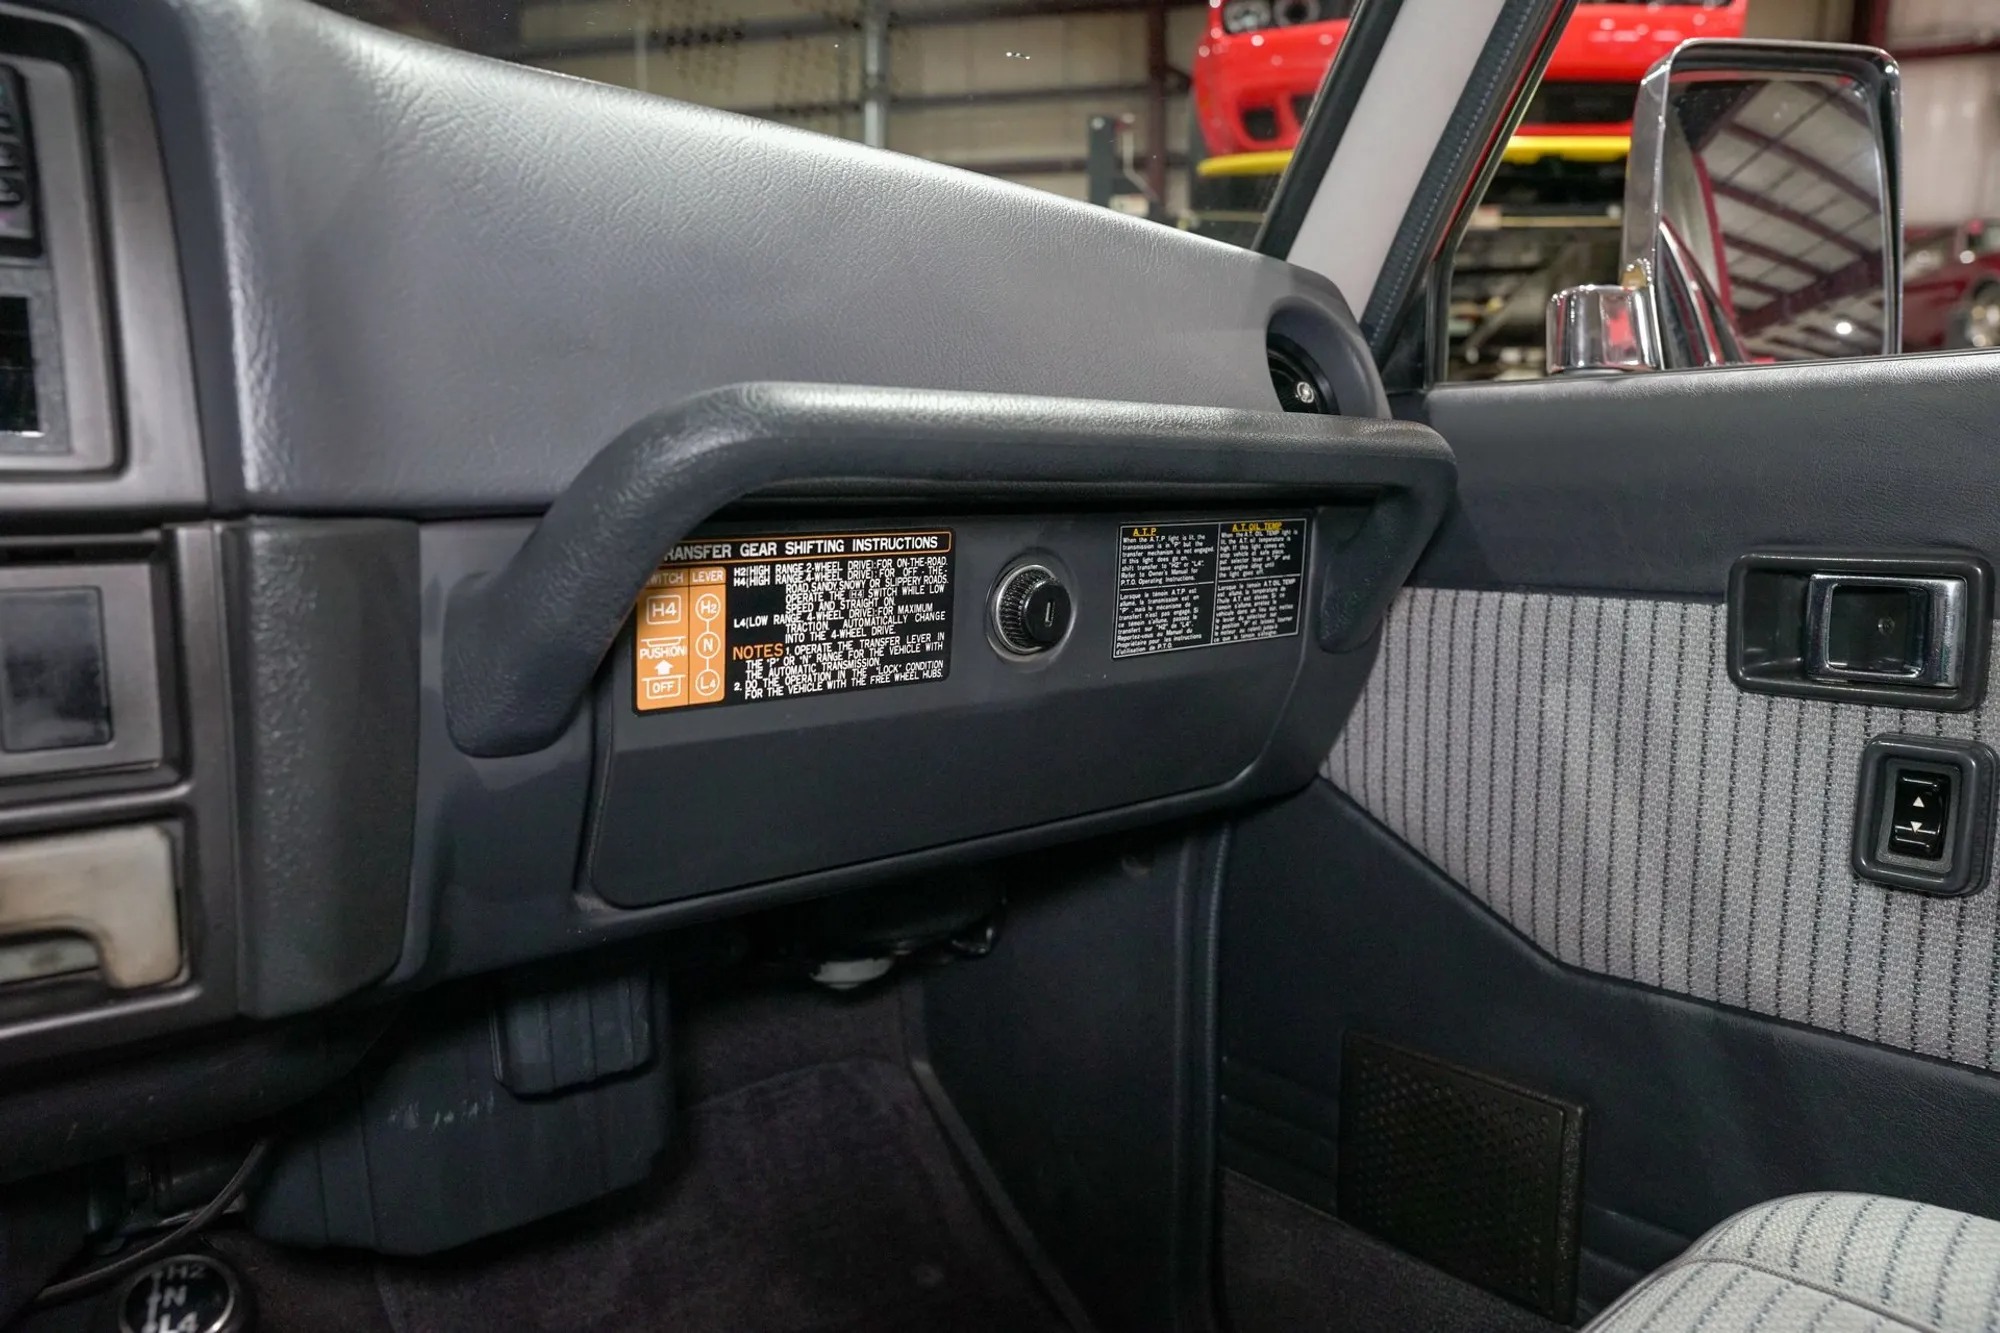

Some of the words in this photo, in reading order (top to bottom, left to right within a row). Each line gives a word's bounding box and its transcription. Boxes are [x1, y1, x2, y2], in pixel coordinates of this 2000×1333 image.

[663, 543, 732, 561] RANSFER
[740, 542, 777, 557] GEAR
[785, 538, 845, 555] SHIFTING
[852, 536, 938, 552] INSTRUCTIONS
[646, 572, 684, 585] WITCH
[692, 570, 724, 583] LEVER
[880, 568, 895, 578] FOR
[903, 567, 918, 576] OFF
[870, 579, 880, 588] OR
[886, 576, 921, 586] SLIPPERY
[786, 592, 824, 604] OPERATE
[829, 590, 845, 601] THE
[868, 587, 897, 597] SWITCH
[902, 585, 925, 595] WHILE
[930, 584, 944, 594] LOW
[652, 602, 677, 617] H4
[700, 600, 717, 614] H2
[786, 603, 814, 614] SPEED
[819, 601, 835, 611] AND
[840, 598, 879, 610] STRAIGHT
[807, 610, 844, 621] 4-WHEEL
[898, 603, 933, 614] MAXIMUM
[843, 615, 908, 628] AUTOMATICALLY
[915, 611, 946, 622] CHANGE
[785, 633, 805, 644] INTO
[810, 631, 826, 640] THE
[831, 628, 866, 640] 4-WHEEL
[795, 643, 832, 655] OPERATE
[838, 641, 853, 651] THE
[860, 636, 900, 649] TRANSFER
[907, 633, 931, 644] LEVER
[938, 632, 944, 640] IN
[703, 638, 713, 652] N
[733, 643, 784, 660] NOTES
[746, 659, 763, 670] THE
[784, 656, 795, 666] OR
[816, 652, 843, 662] RANGE
[848, 650, 864, 659] FOR
[869, 647, 884, 657] THE
[889, 643, 920, 655] VEHICLE
[925, 642, 942, 651] WITH
[734, 682, 742, 691] 2.
[745, 680, 758, 690] DO
[763, 678, 780, 688] THE
[785, 671, 831, 686] OPERATION
[838, 670, 845, 679] IN
[852, 668, 867, 678] THE
[906, 660, 943, 672] CONDITION
[746, 669, 763, 680] THE
[768, 663, 816, 677] AUTOMATIC
[652, 680, 674, 693] OFF
[700, 676, 716, 690] L4
[745, 689, 763, 699] FOR
[767, 686, 784, 696] THE
[788, 682, 822, 694] VEHICLE
[827, 678, 846, 689] WITH
[851, 678, 866, 686] THE
[870, 674, 890, 684] FREE
[894, 671, 919, 681] WHEEL
[162, 1285, 187, 1308] N
[158, 1311, 198, 1333] L4
